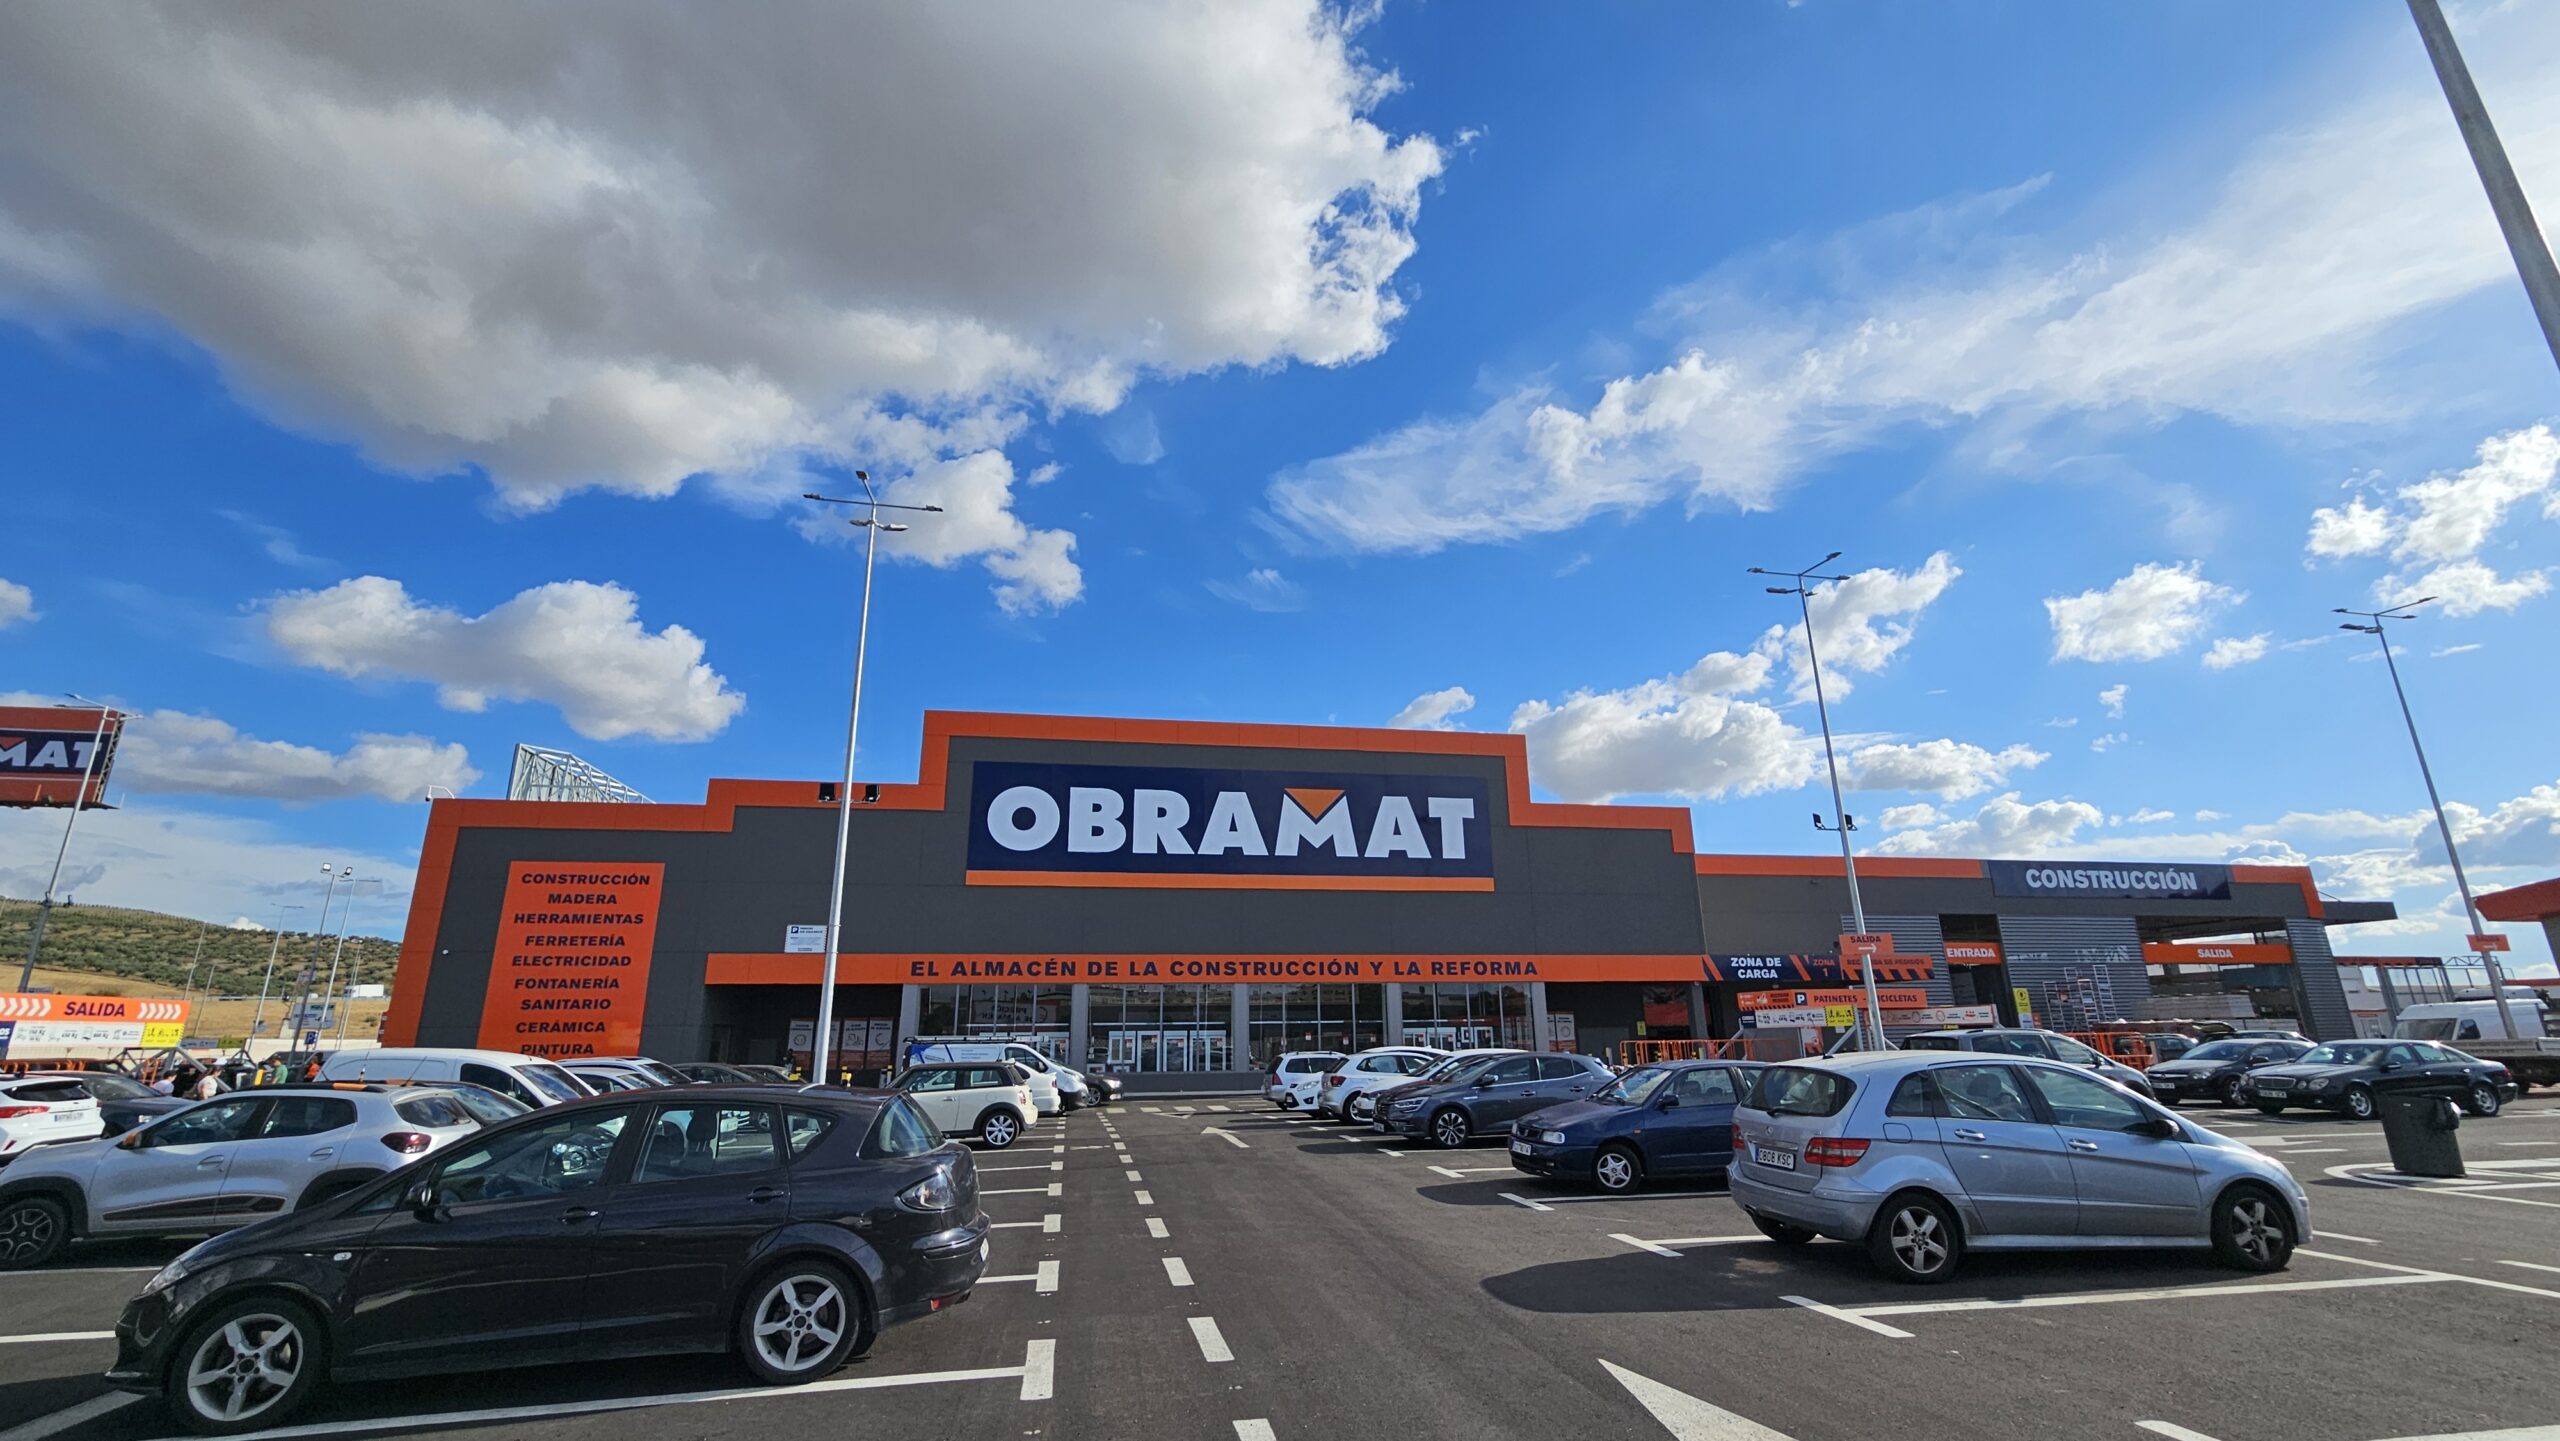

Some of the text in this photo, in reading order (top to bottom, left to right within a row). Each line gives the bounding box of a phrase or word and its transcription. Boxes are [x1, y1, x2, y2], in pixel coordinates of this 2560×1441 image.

[987, 786, 1475, 859] OBRAMAT
[521, 873, 650, 885] CONSTRUCCIÓN
[2025, 868, 2198, 890] CONSTRUCCIÓN
[547, 894, 617, 904] MADERA
[514, 914, 644, 924] HERRAMIENTAS
[525, 934, 625, 946] FERRETERÍA
[1946, 948, 1996, 958] ENTRADA
[2197, 949, 2234, 958] SALIDA
[512, 955, 632, 966] ELECTRICIDAD
[1731, 957, 1782, 967] ZONA DE
[911, 958, 1539, 976] EL ALMACÉN DE LA CONSTRUCCIÓN Y LA REFORMA
[1738, 969, 1778, 978] CARGA
[514, 976, 620, 989] FONTANERÍA
[1814, 995, 1857, 1003] PATINETES
[1872, 994, 1917, 1002] ICICLETAS
[64, 1002, 125, 1017] SALIDA
[520, 999, 611, 1010] SANITARIO
[516, 1020, 606, 1033] CERÁMICA
[521, 1044, 594, 1055] PINTURA
